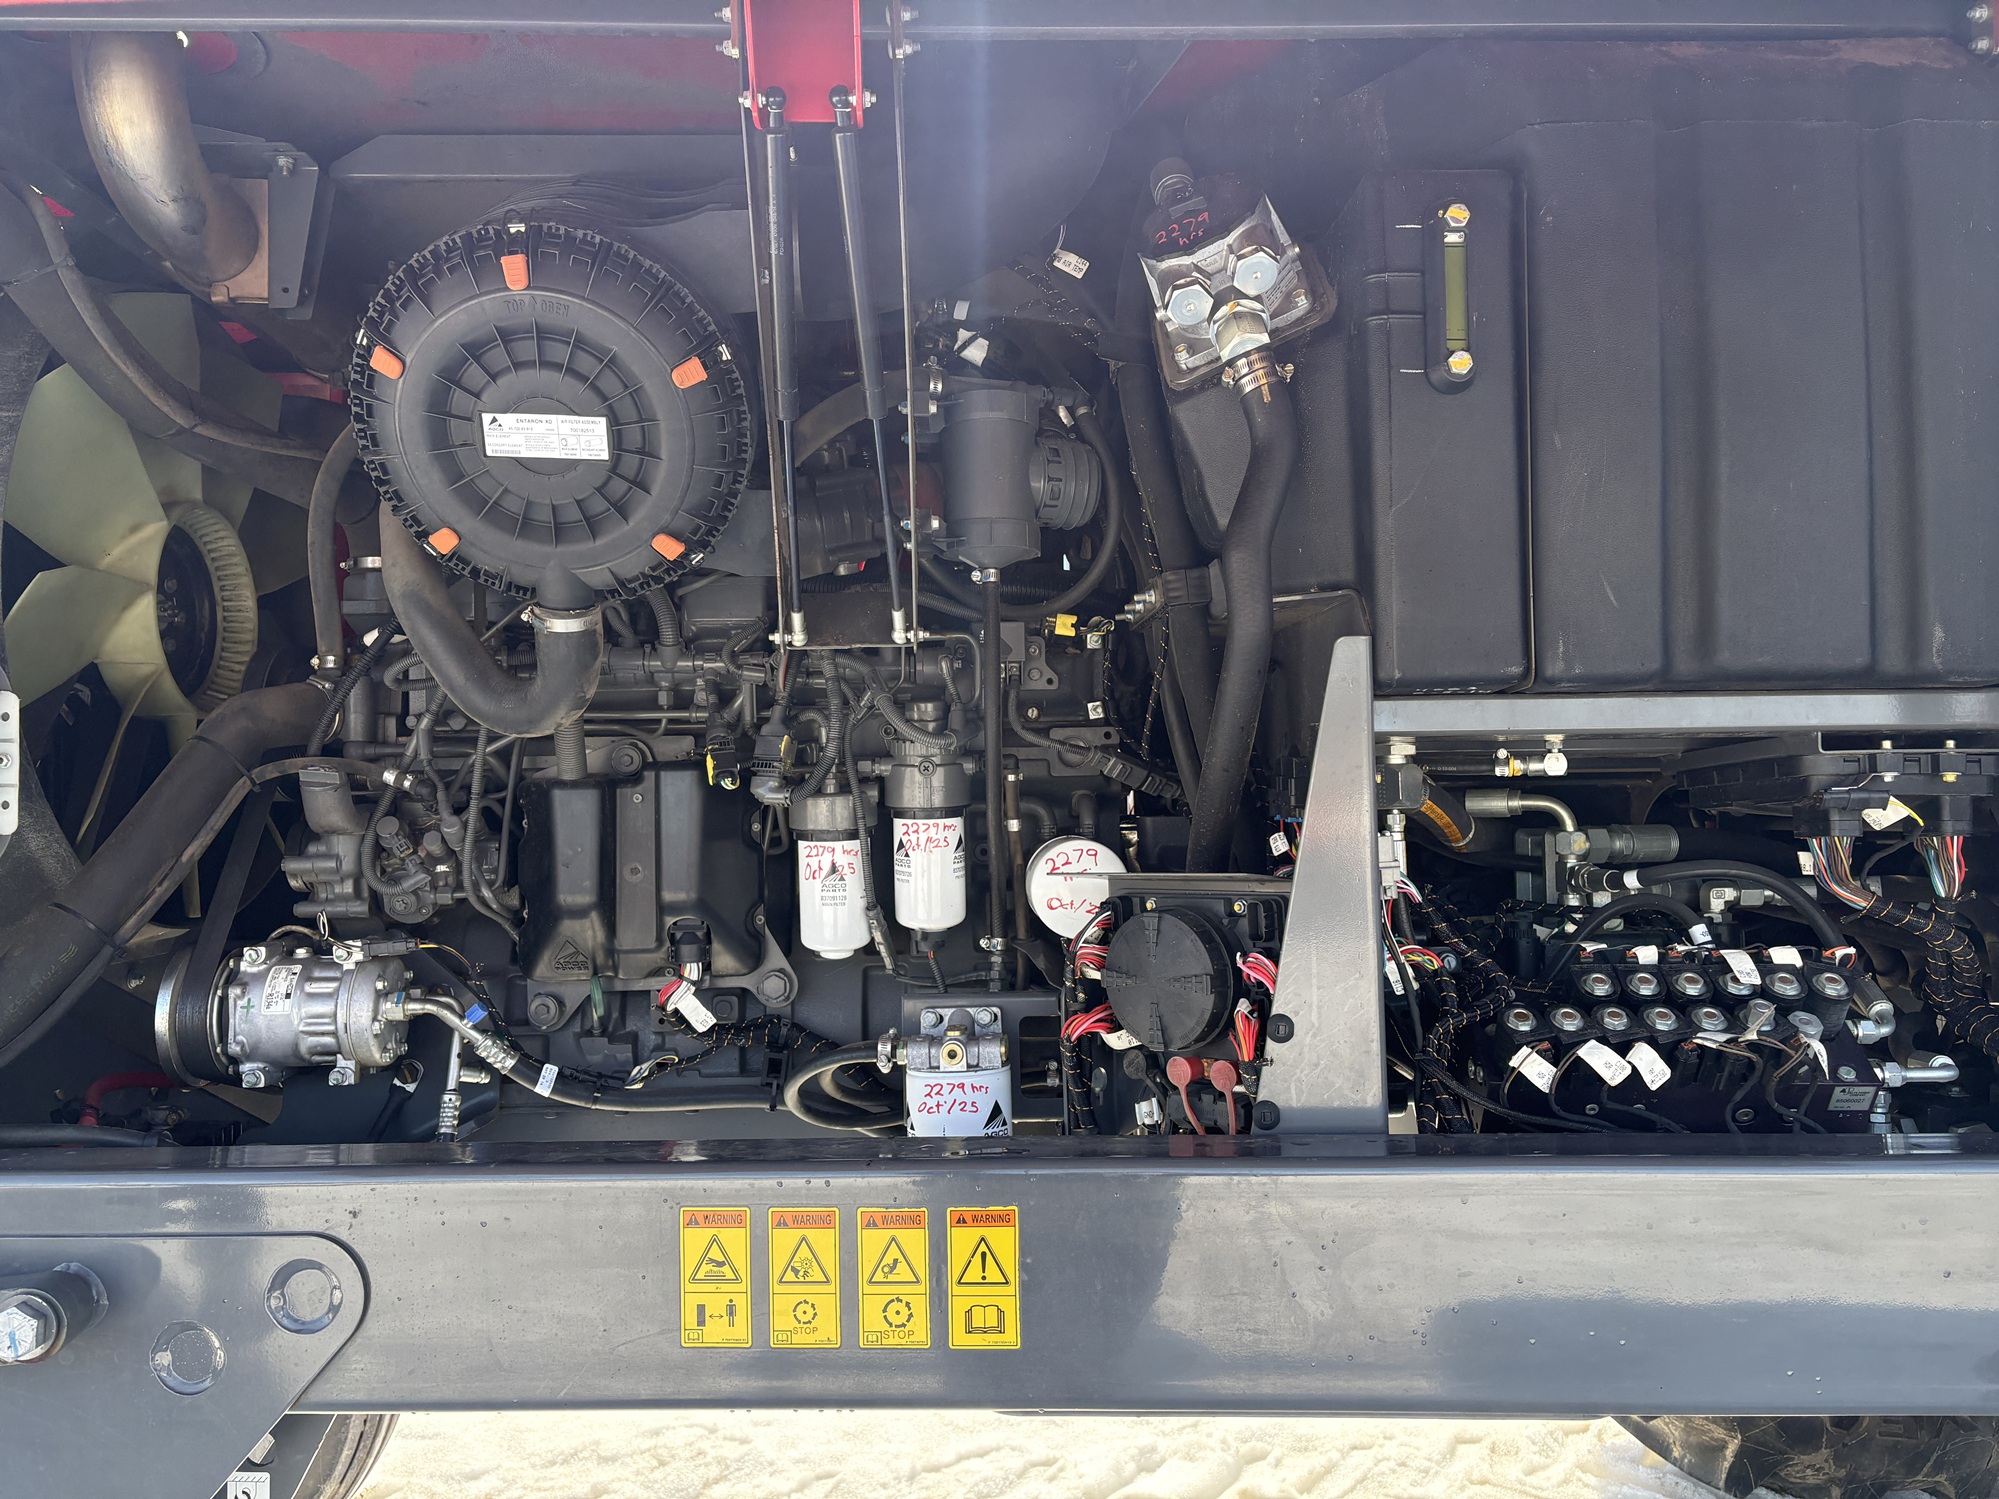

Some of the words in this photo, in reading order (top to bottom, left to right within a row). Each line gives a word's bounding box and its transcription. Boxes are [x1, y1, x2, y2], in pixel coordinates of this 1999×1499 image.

[1156, 211, 1211, 244] 2279
[504, 298, 526, 314] TOP
[541, 299, 570, 317] OBEN
[901, 821, 940, 837] 2279
[943, 822, 958, 832] hrs
[804, 844, 836, 859] 2279
[842, 844, 860, 857] hrs
[1045, 848, 1099, 874] 2279
[924, 1082, 968, 1099] 2279
[971, 1083, 990, 1095] hrs
[984, 1128, 1009, 1137] AGCO
[703, 1213, 743, 1225] WARNING
[791, 1214, 832, 1226] WARNING
[881, 1214, 922, 1226] WARNING
[971, 1213, 1011, 1224] WARNING
[792, 1326, 818, 1335] STOP
[882, 1329, 915, 1340] STOP
